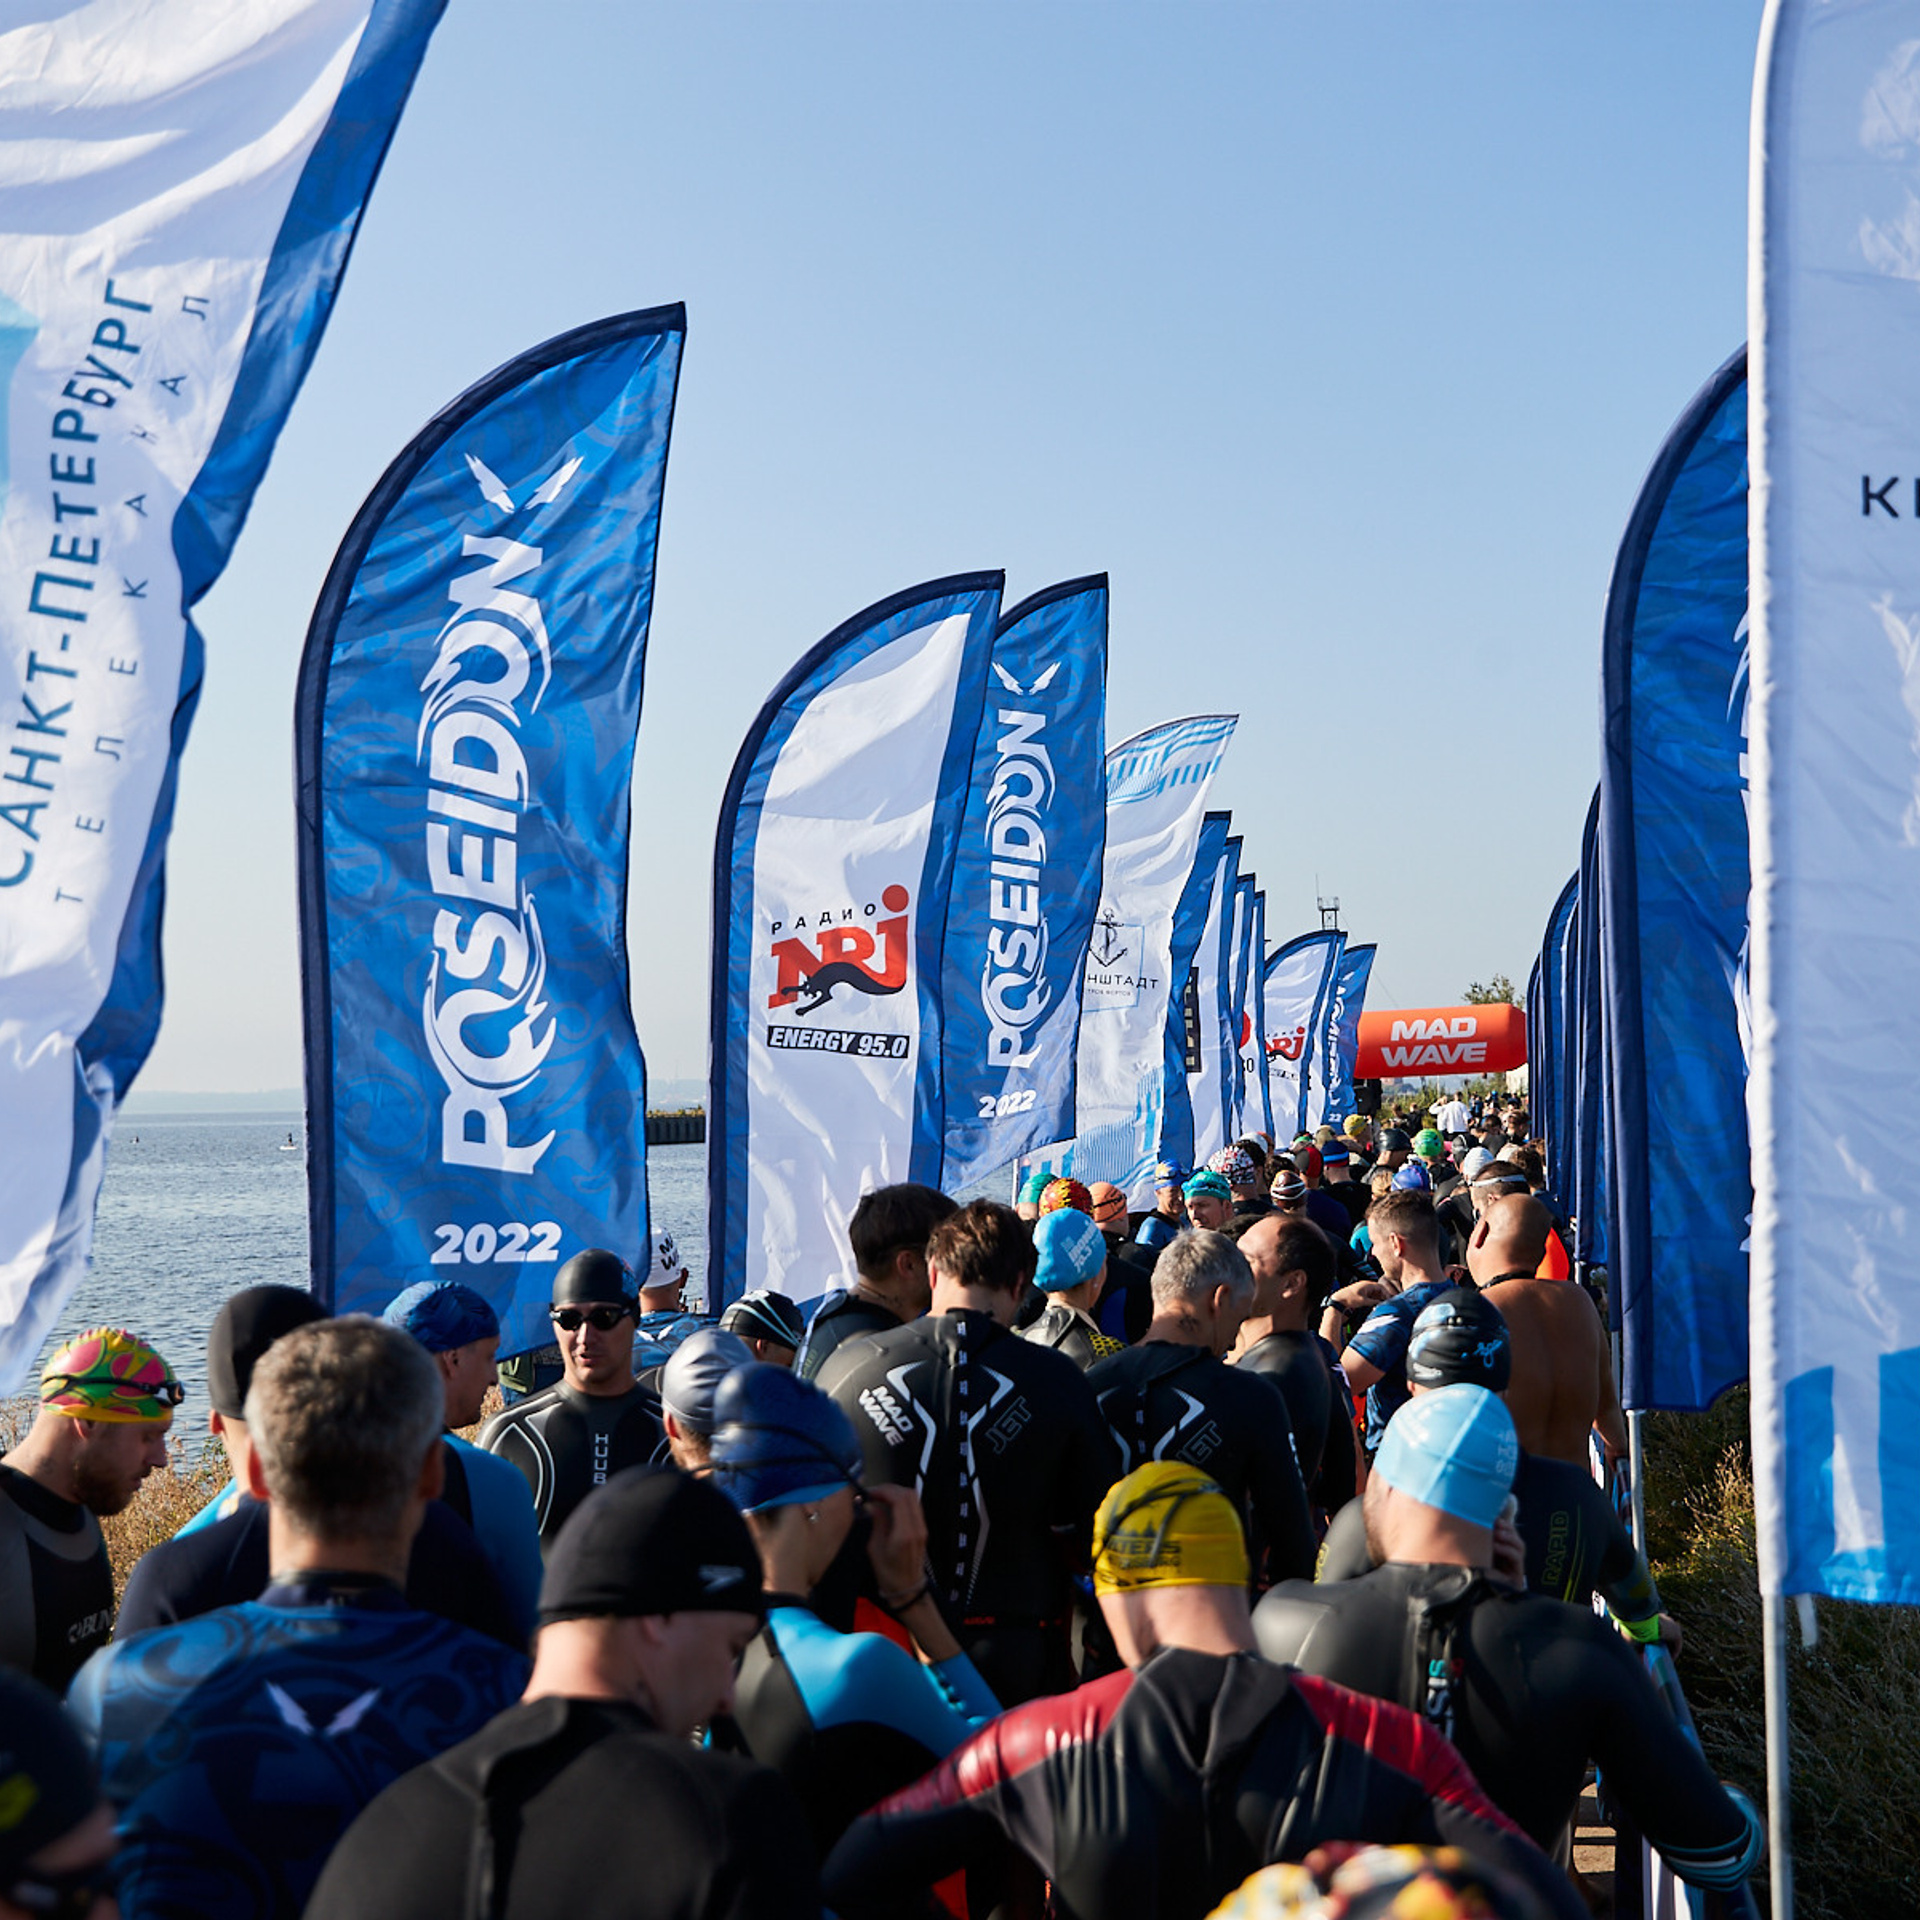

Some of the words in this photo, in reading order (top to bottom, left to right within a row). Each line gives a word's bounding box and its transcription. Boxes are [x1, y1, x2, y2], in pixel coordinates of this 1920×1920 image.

[1862, 475, 1920, 518] К
[0, 278, 153, 886] САНКТ-ПЕТЕРБУРГ
[417, 535, 556, 1174] POSEIDON
[980, 709, 1055, 1068] POSEIDON
[771, 903, 876, 935] РАДИО
[1087, 974, 1159, 990] НШТАДТ
[769, 1027, 856, 1051] ENERGY
[857, 1034, 907, 1057] 95.0
[1390, 1016, 1477, 1041] MAD
[1381, 1042, 1487, 1067] WAVE
[978, 1090, 1037, 1118] 2022
[431, 1222, 561, 1265] 2022
[858, 1388, 904, 1447] WAVE
[872, 1385, 914, 1432] MAD
[984, 1395, 1032, 1455] JET
[593, 1433, 609, 1485] HUUB
